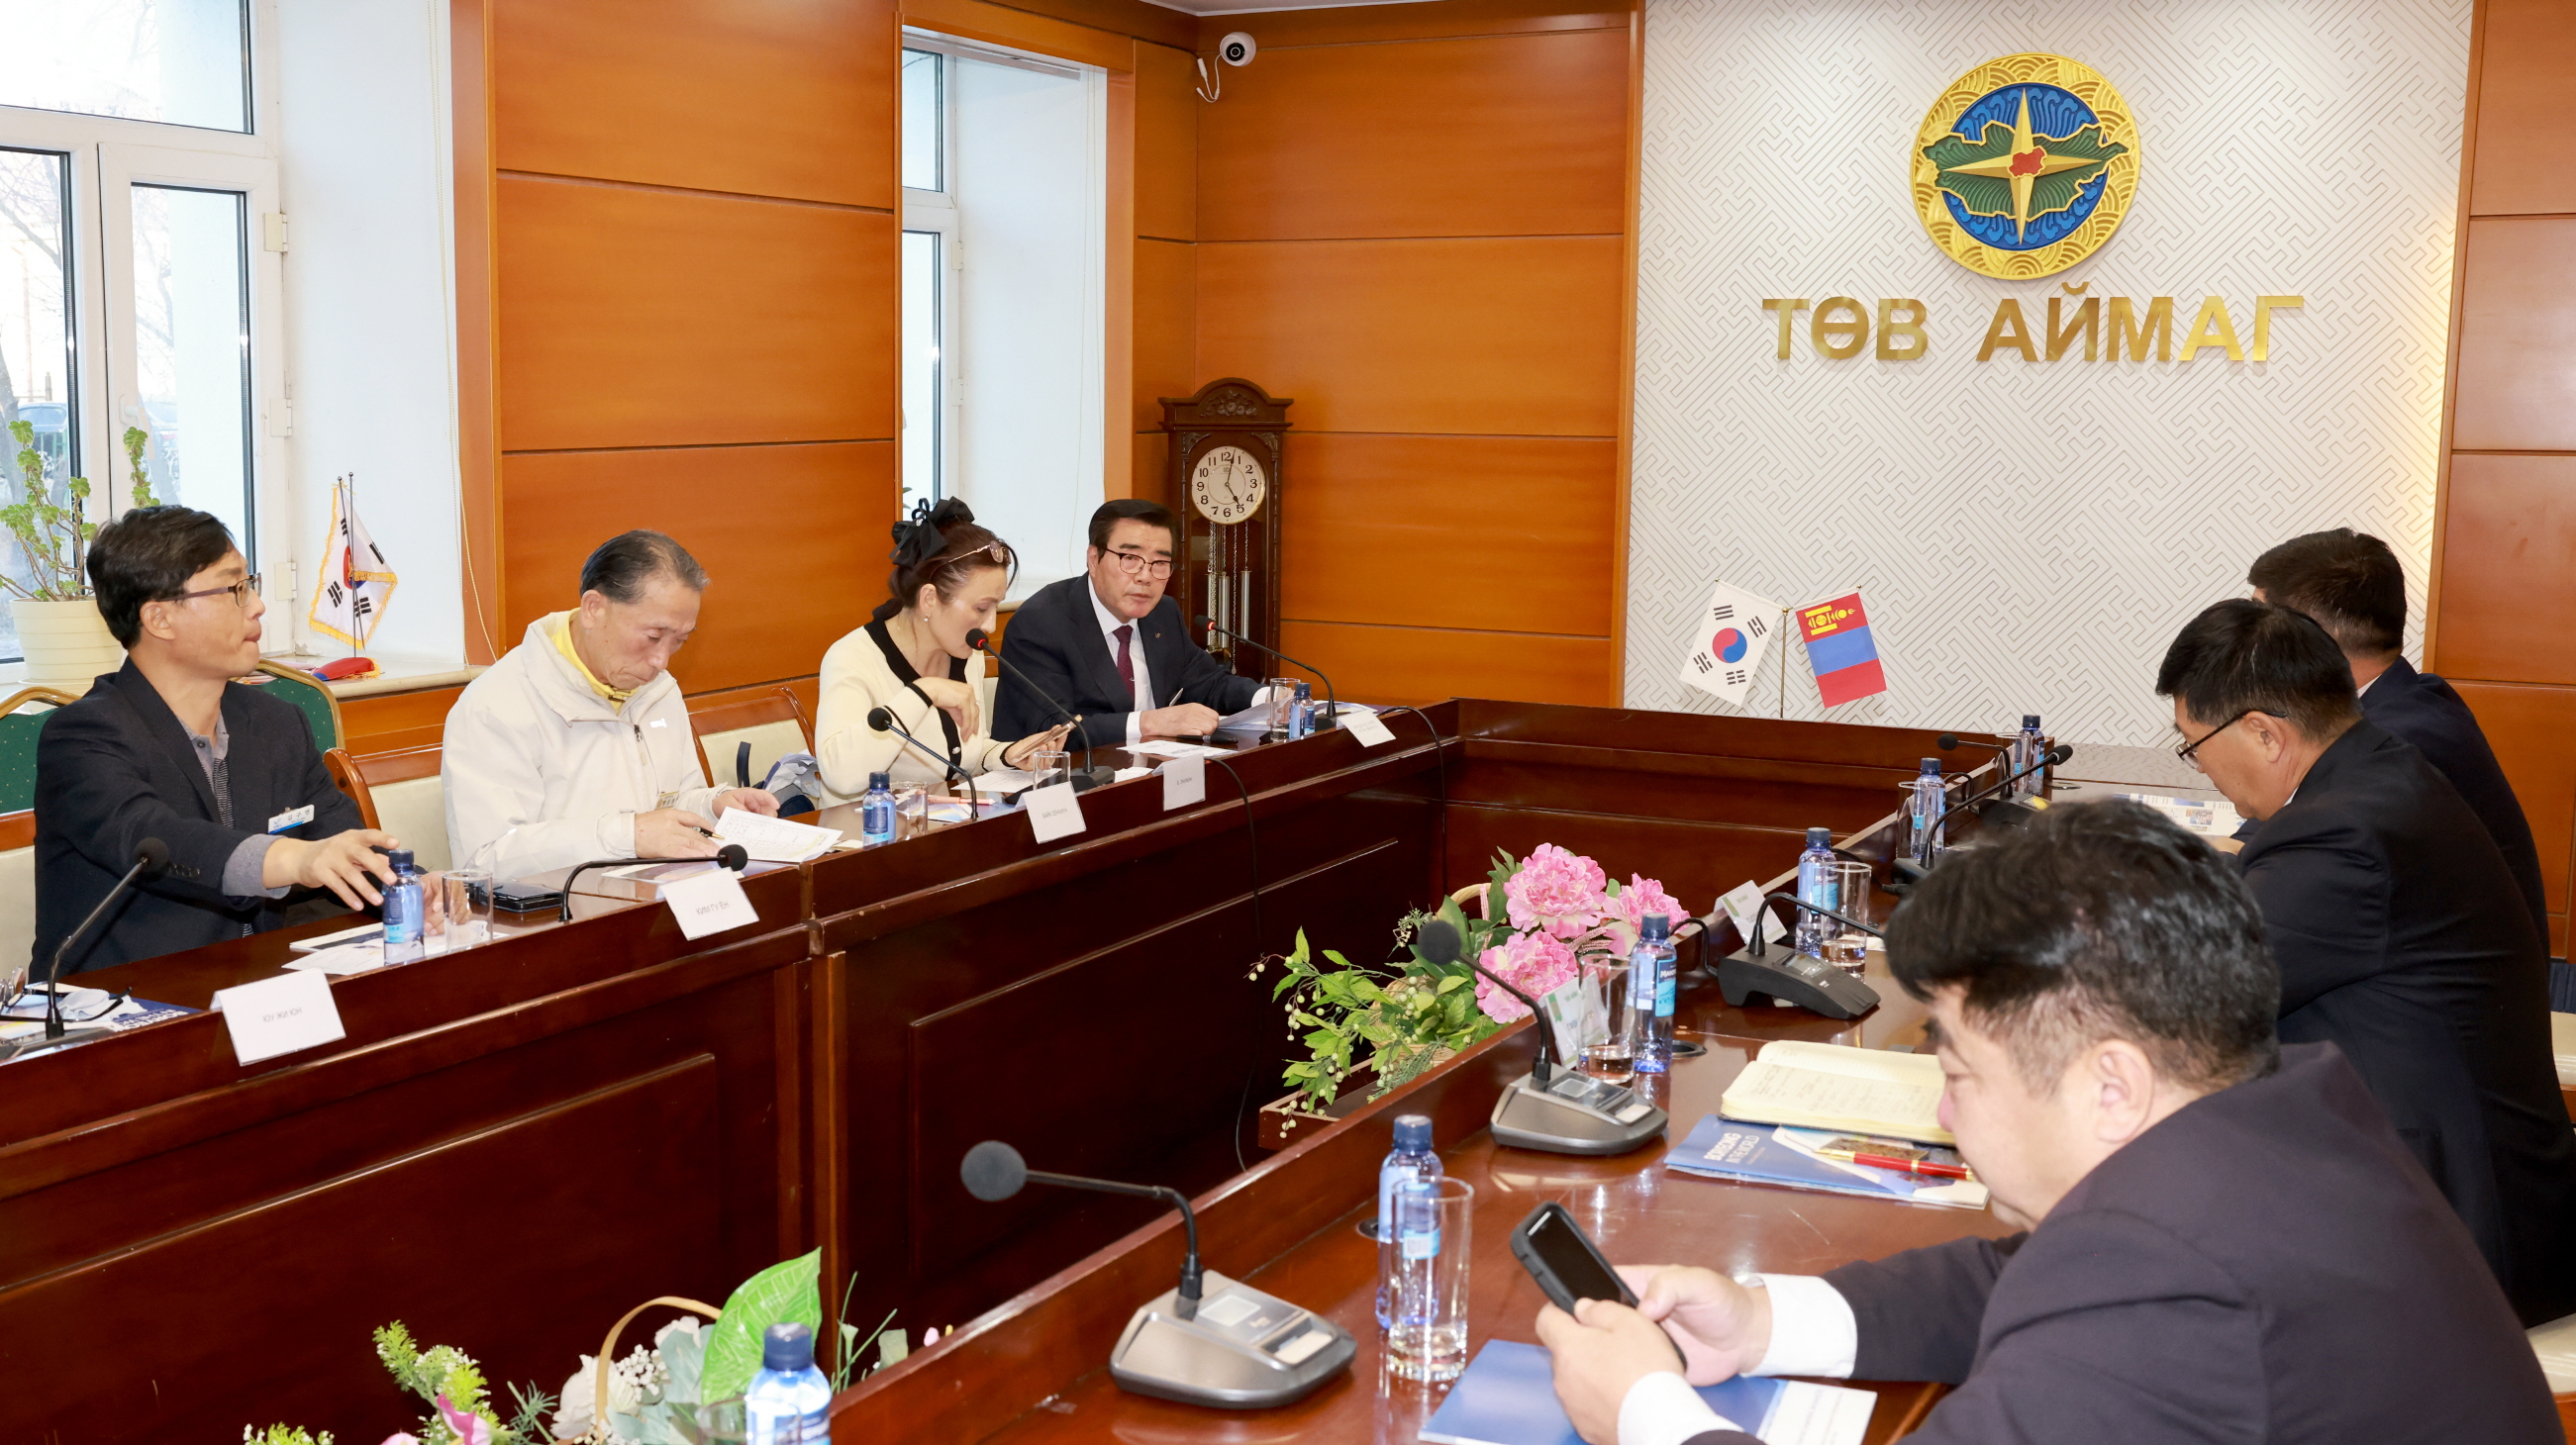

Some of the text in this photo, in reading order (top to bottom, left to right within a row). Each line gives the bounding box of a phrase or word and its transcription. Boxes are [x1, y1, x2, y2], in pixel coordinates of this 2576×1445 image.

[1762, 281, 2304, 361] ТӨВ АЙМАГ
[1221, 452, 1232, 461] 12
[1208, 457, 1217, 466] 11
[1199, 467, 1209, 477] 10
[1245, 465, 1253, 474] 2
[1197, 482, 1205, 491] 9
[1249, 478, 1258, 489] 3
[1200, 495, 1209, 505] 8
[1246, 493, 1253, 502] 4
[1211, 506, 1219, 515] 7
[1223, 507, 1232, 518] 6
[1237, 504, 1244, 514] 5
